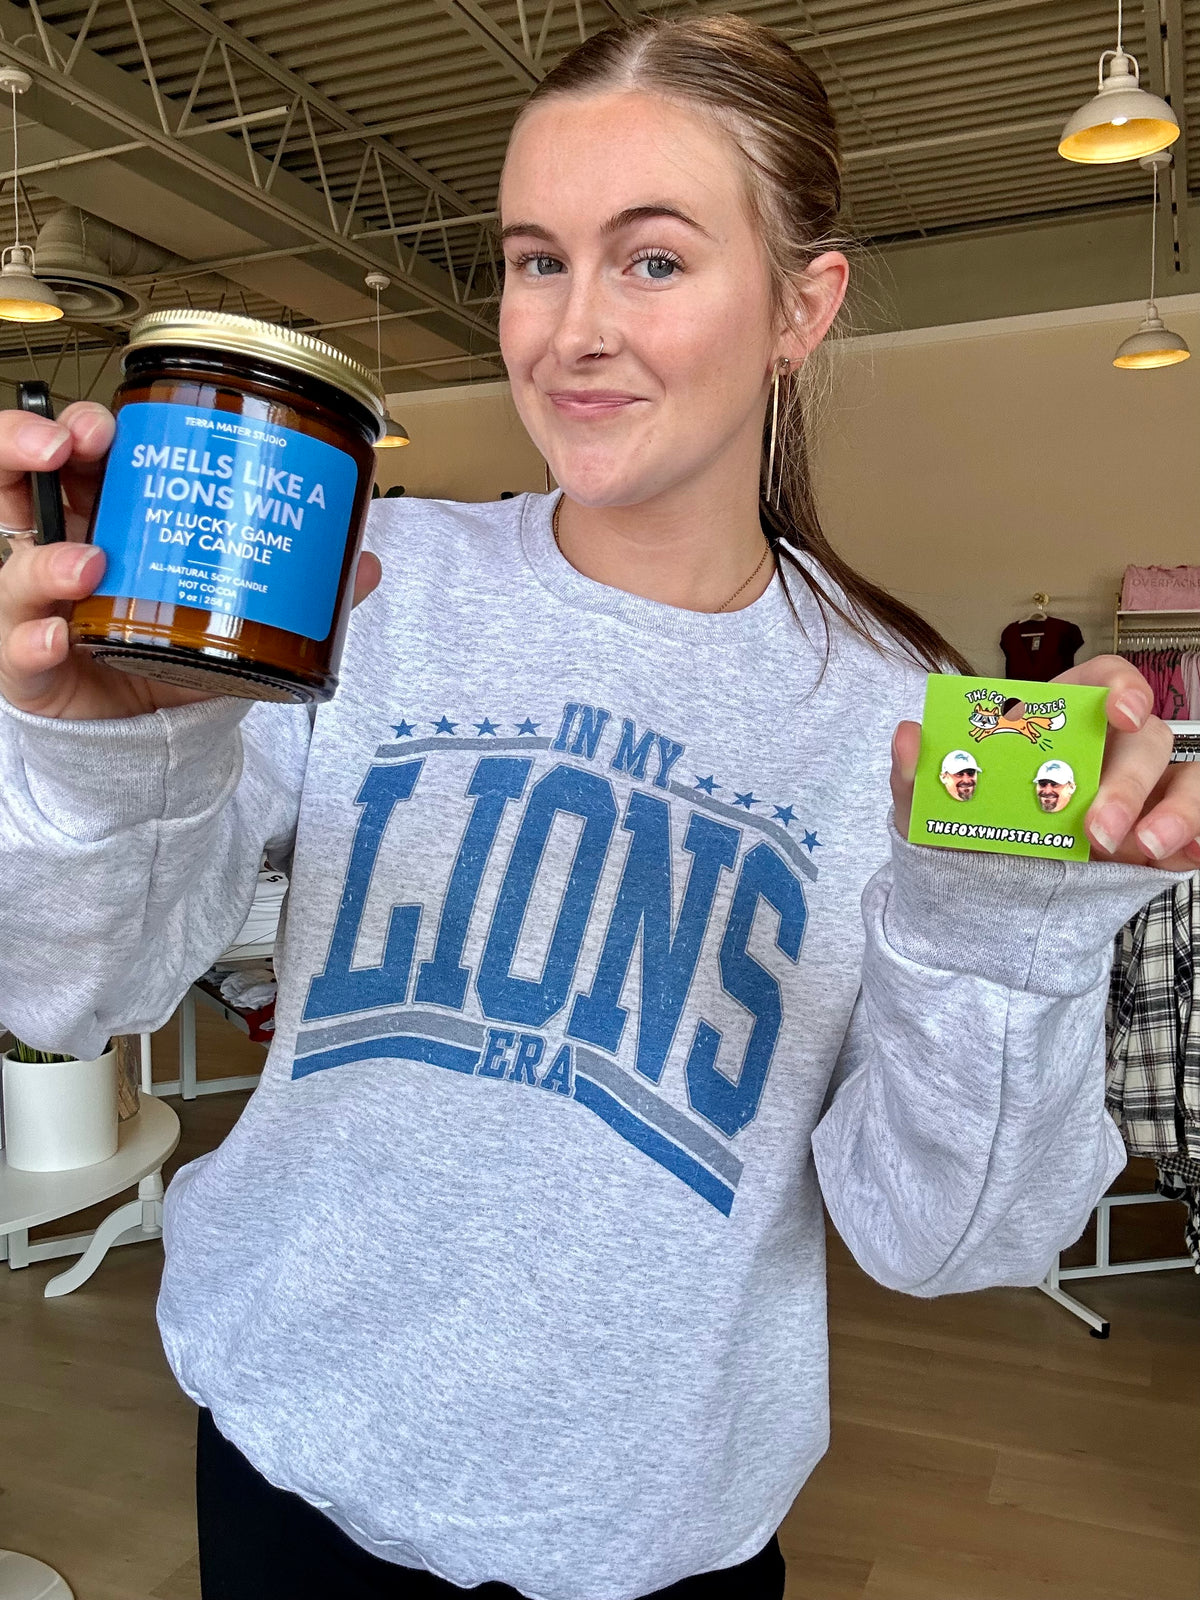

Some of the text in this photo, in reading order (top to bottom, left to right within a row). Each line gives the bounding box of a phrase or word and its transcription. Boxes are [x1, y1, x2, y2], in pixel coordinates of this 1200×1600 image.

[185, 416, 287, 447] TERRA MATER STUDIO
[131, 444, 326, 510] SMELLS LIKE A
[144, 474, 304, 531] LIONS WIN
[145, 508, 293, 552] MY LUCKY GAME
[159, 528, 272, 564] DAY CANDLE
[149, 562, 269, 594] ALL-NATURAL SOY CANDLE
[178, 579, 237, 599] HOT COCOA
[178, 591, 186, 599] 9
[965, 689, 988, 703] THE
[549, 702, 686, 791] IN MY
[926, 819, 1074, 848] THEFOXYHIPSTER.COM
[302, 755, 809, 1140] LIONS
[474, 1026, 577, 1098] ERA
